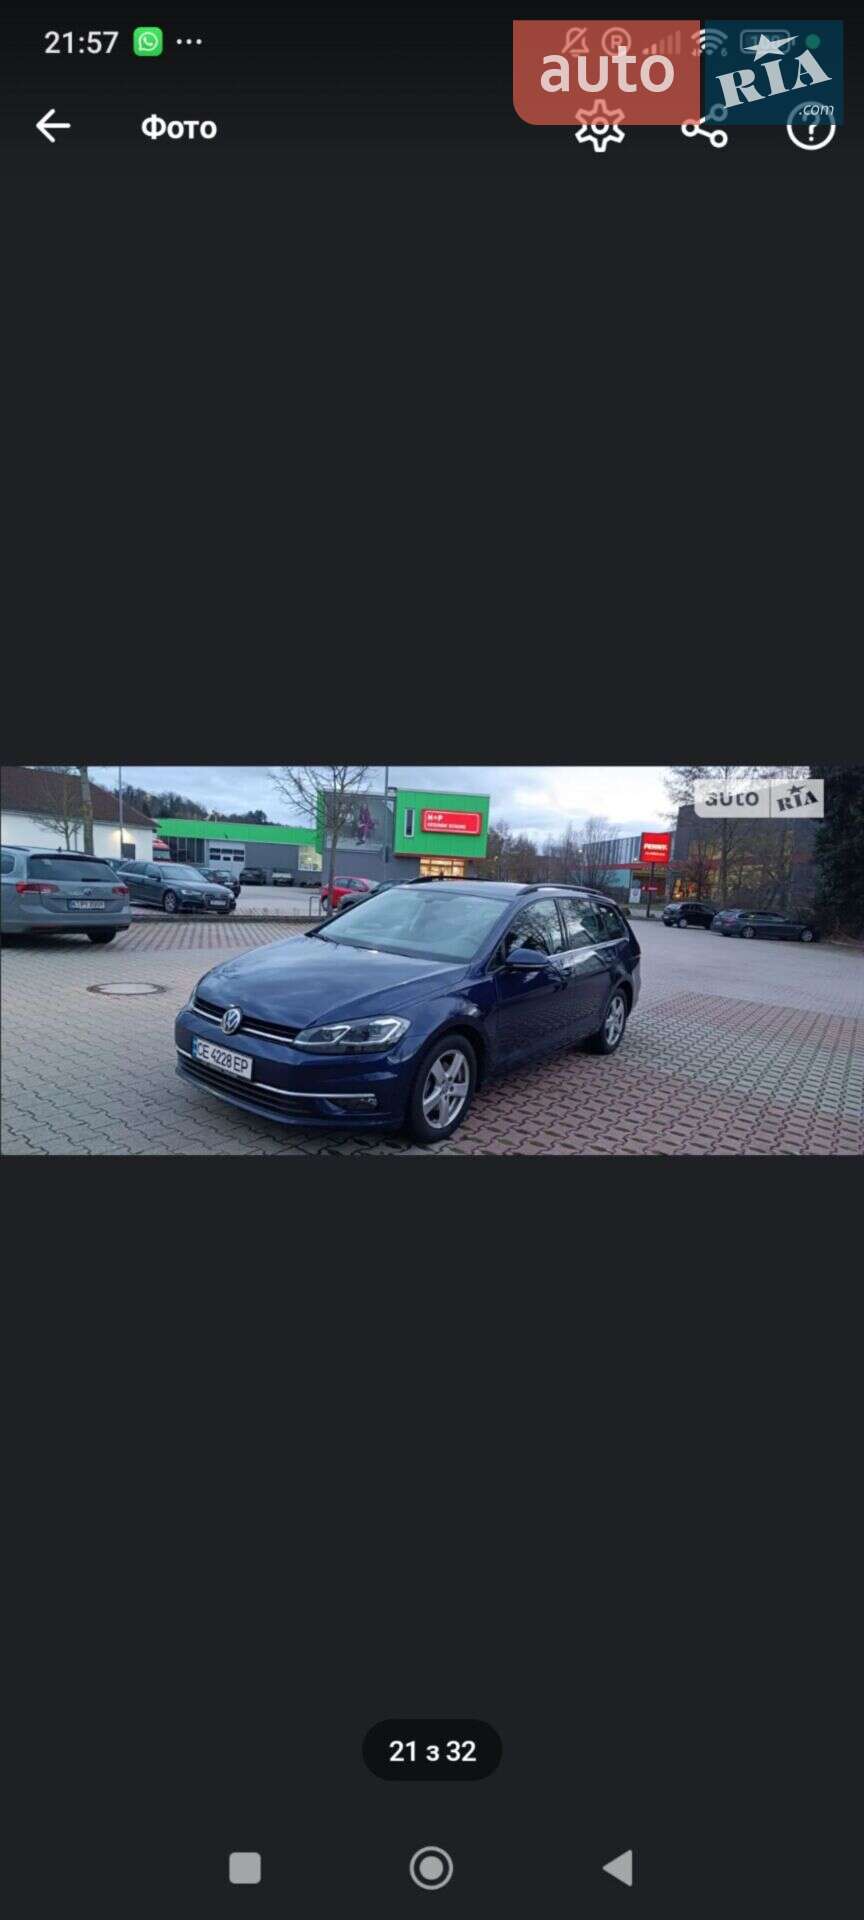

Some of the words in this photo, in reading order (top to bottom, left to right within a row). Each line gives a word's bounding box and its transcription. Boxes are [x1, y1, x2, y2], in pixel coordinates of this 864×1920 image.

[44, 31, 119, 54] 21:57
[141, 114, 218, 139] Фото
[197, 1042, 210, 1060] CE
[211, 1048, 232, 1068] 4228
[234, 1055, 249, 1073] EP
[389, 1740, 416, 1761] 21
[426, 1744, 440, 1761] з
[446, 1740, 477, 1761] 32
